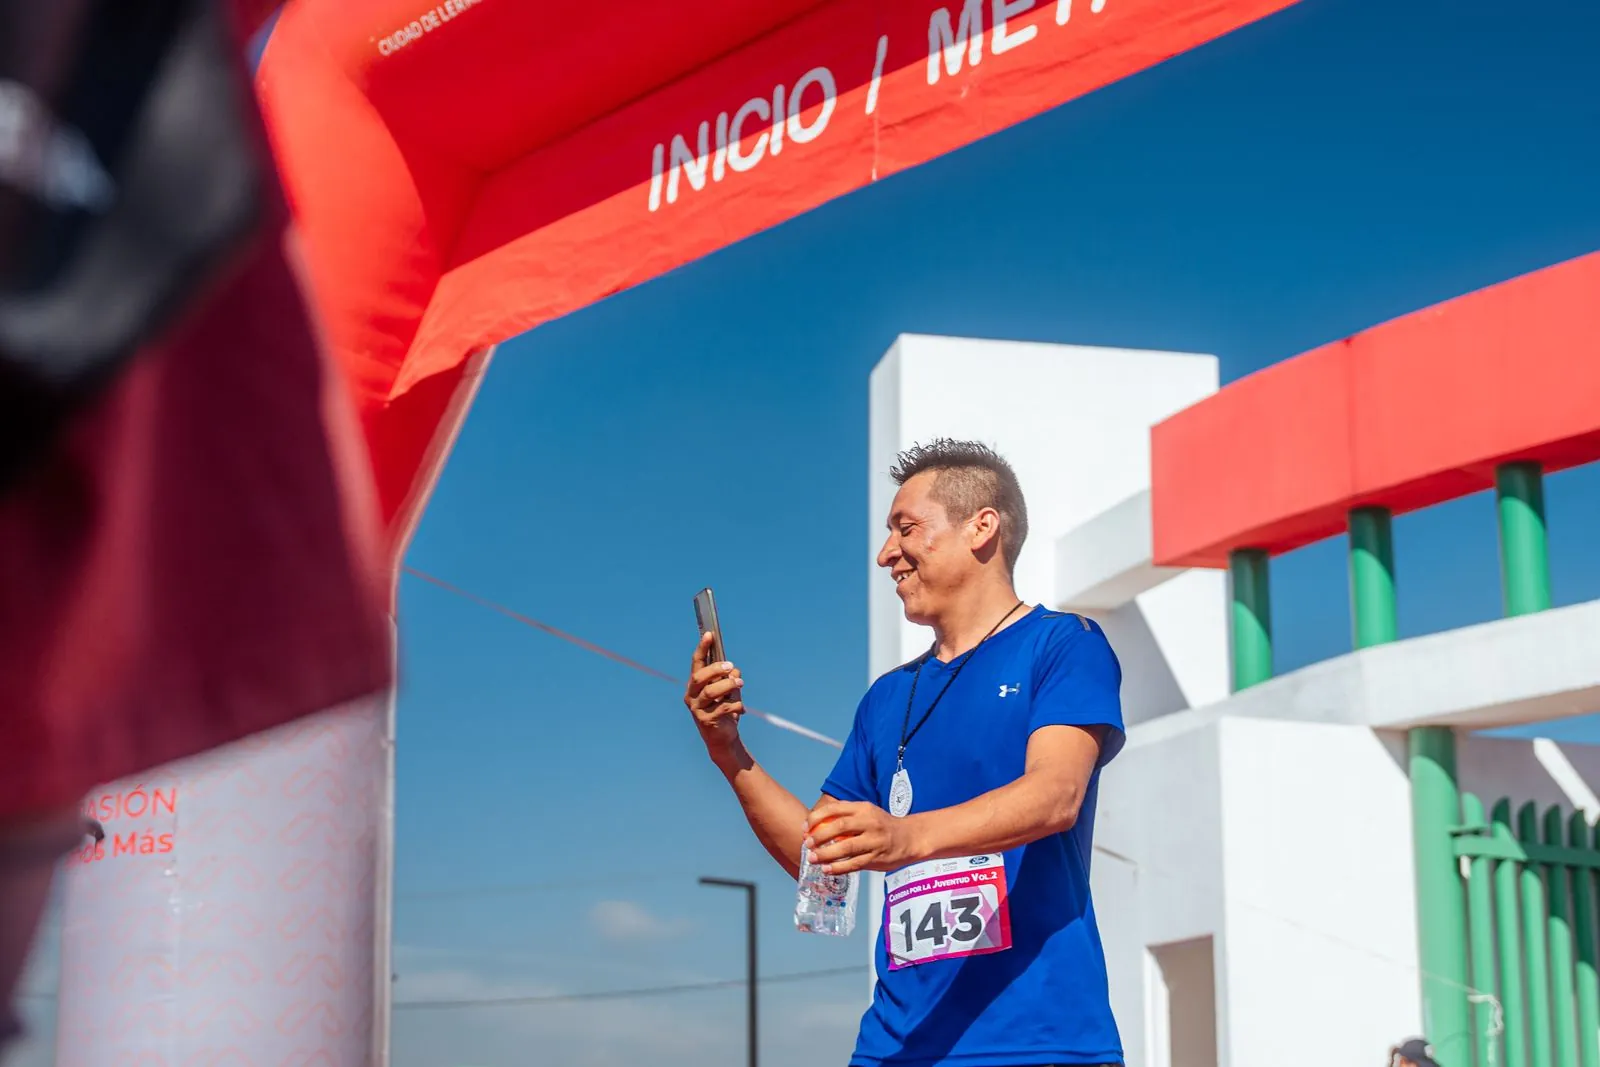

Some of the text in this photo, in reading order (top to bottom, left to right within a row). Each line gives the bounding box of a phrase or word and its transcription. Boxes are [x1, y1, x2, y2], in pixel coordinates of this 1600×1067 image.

[420, 10, 441, 32] DE
[648, 0, 1107, 211] INICIO / ME
[80, 784, 176, 823] ASIÓN
[112, 827, 174, 858] Más
[899, 896, 982, 952] 143
